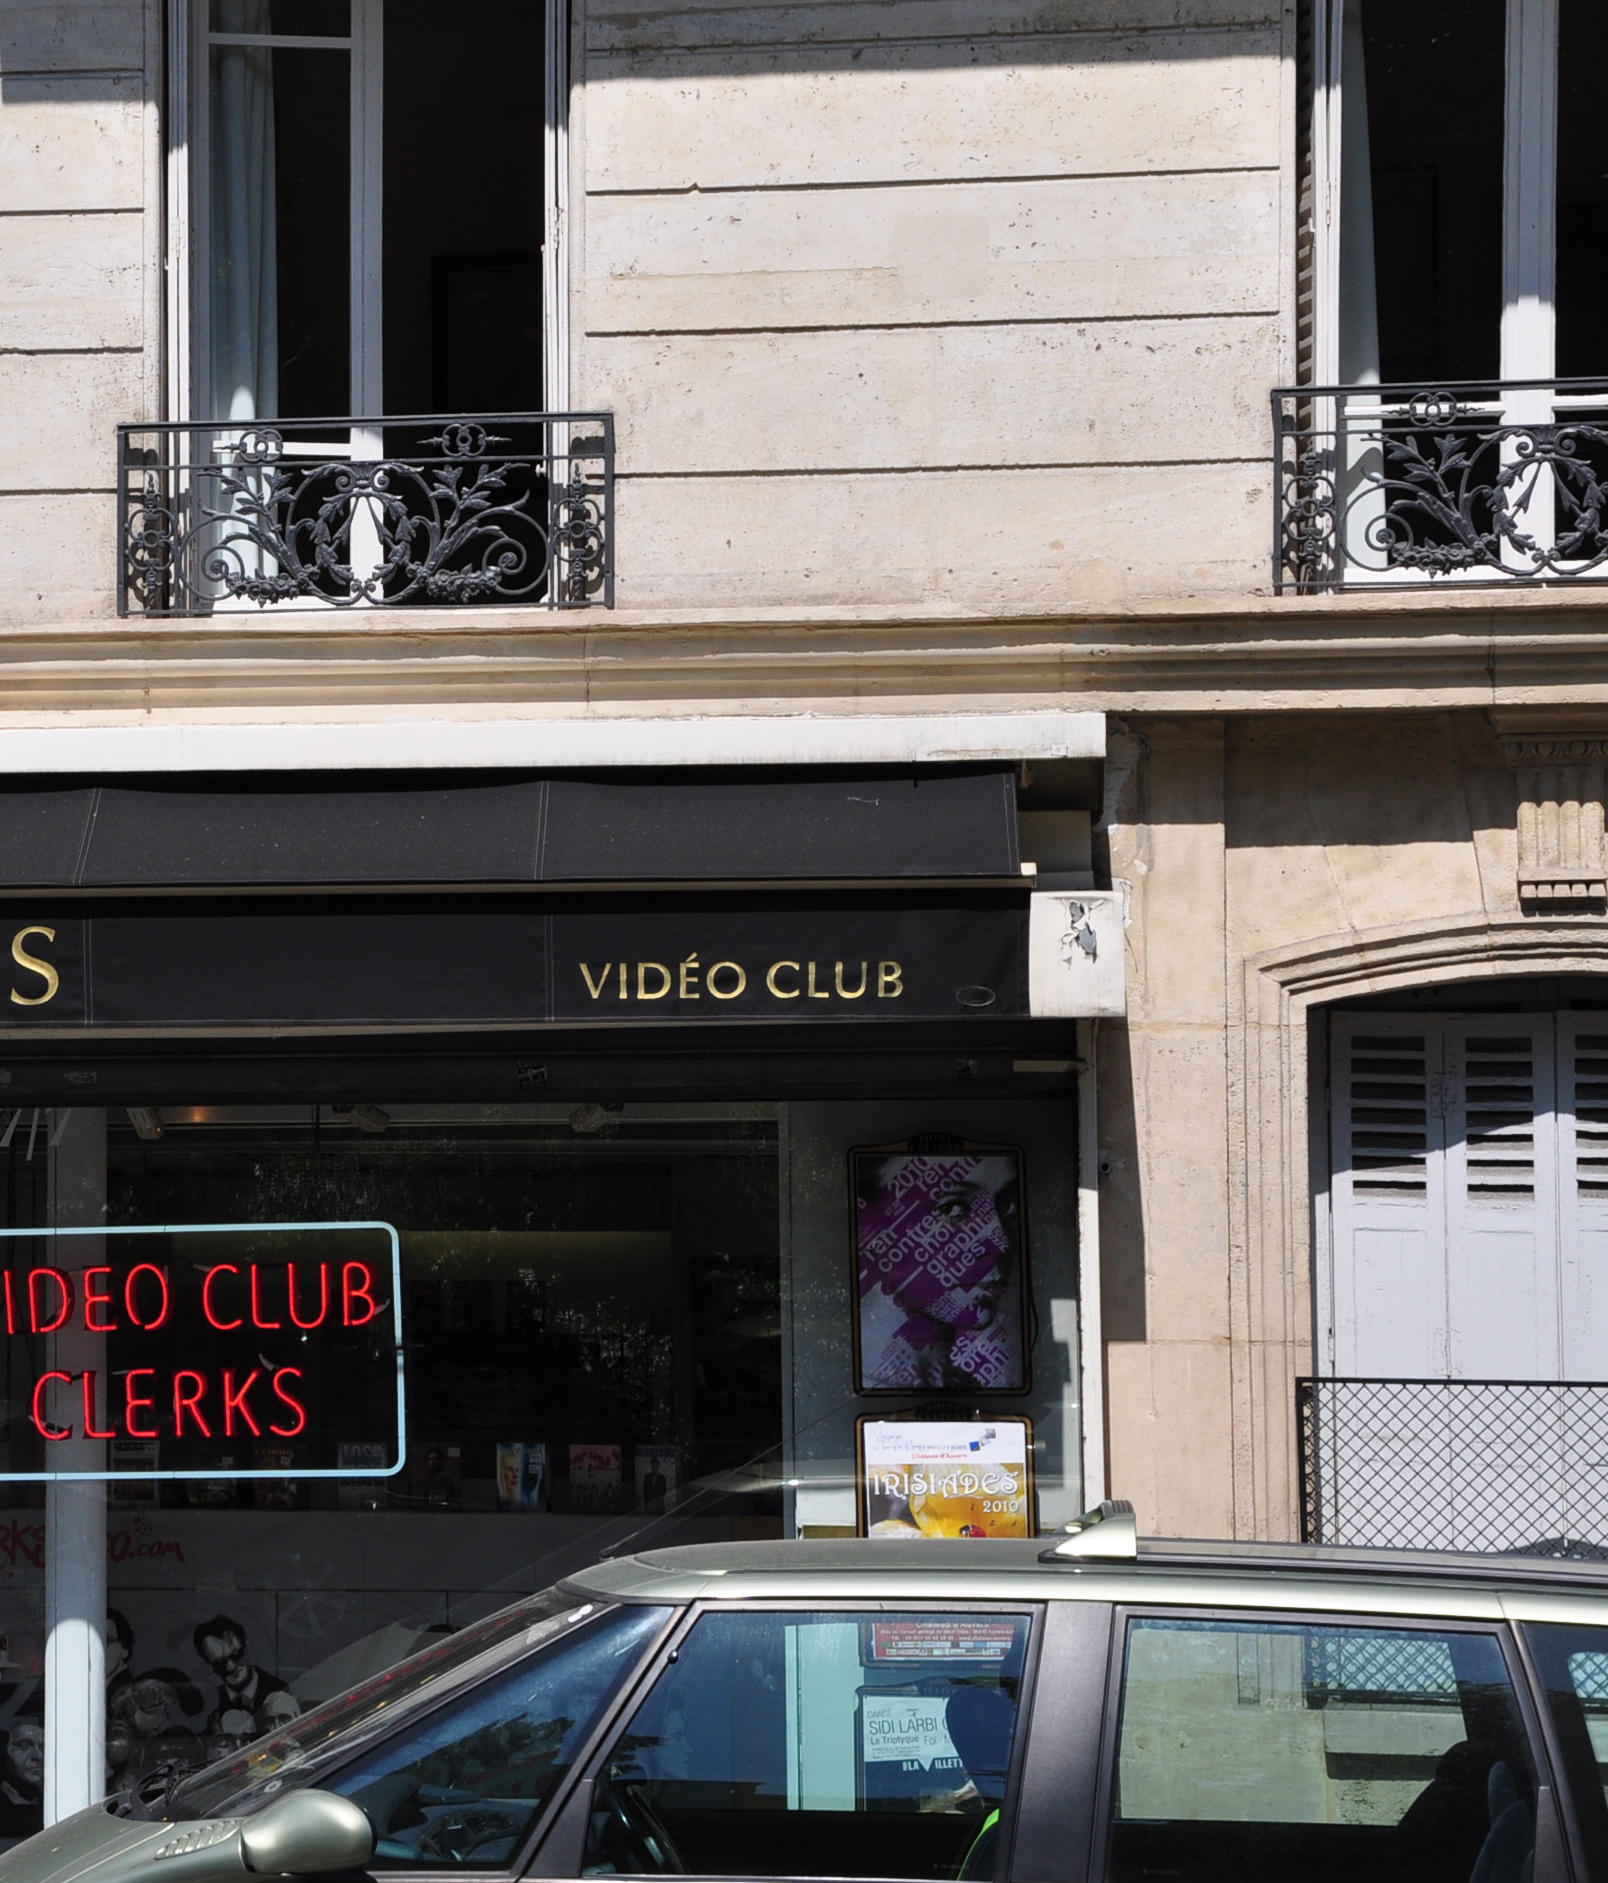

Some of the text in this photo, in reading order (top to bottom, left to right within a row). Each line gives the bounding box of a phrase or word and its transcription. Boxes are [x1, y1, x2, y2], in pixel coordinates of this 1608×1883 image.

[579, 952, 905, 1000] VIDÉO CLUB
[936, 1241, 986, 1288] ques
[202, 1260, 379, 1331] CLUB
[32, 1366, 306, 1441] CLERKS
[873, 1469, 1020, 1499] IRISIADES
[982, 1500, 1019, 1513] 2010
[867, 1709, 892, 1719] DANSE
[869, 1720, 895, 1735] SIDI
[899, 1717, 938, 1734] LARBI
[870, 1737, 880, 1746] Le
[882, 1735, 920, 1746] Triptyque
[924, 1736, 937, 1746] Foi
[909, 1760, 920, 1771] LA
